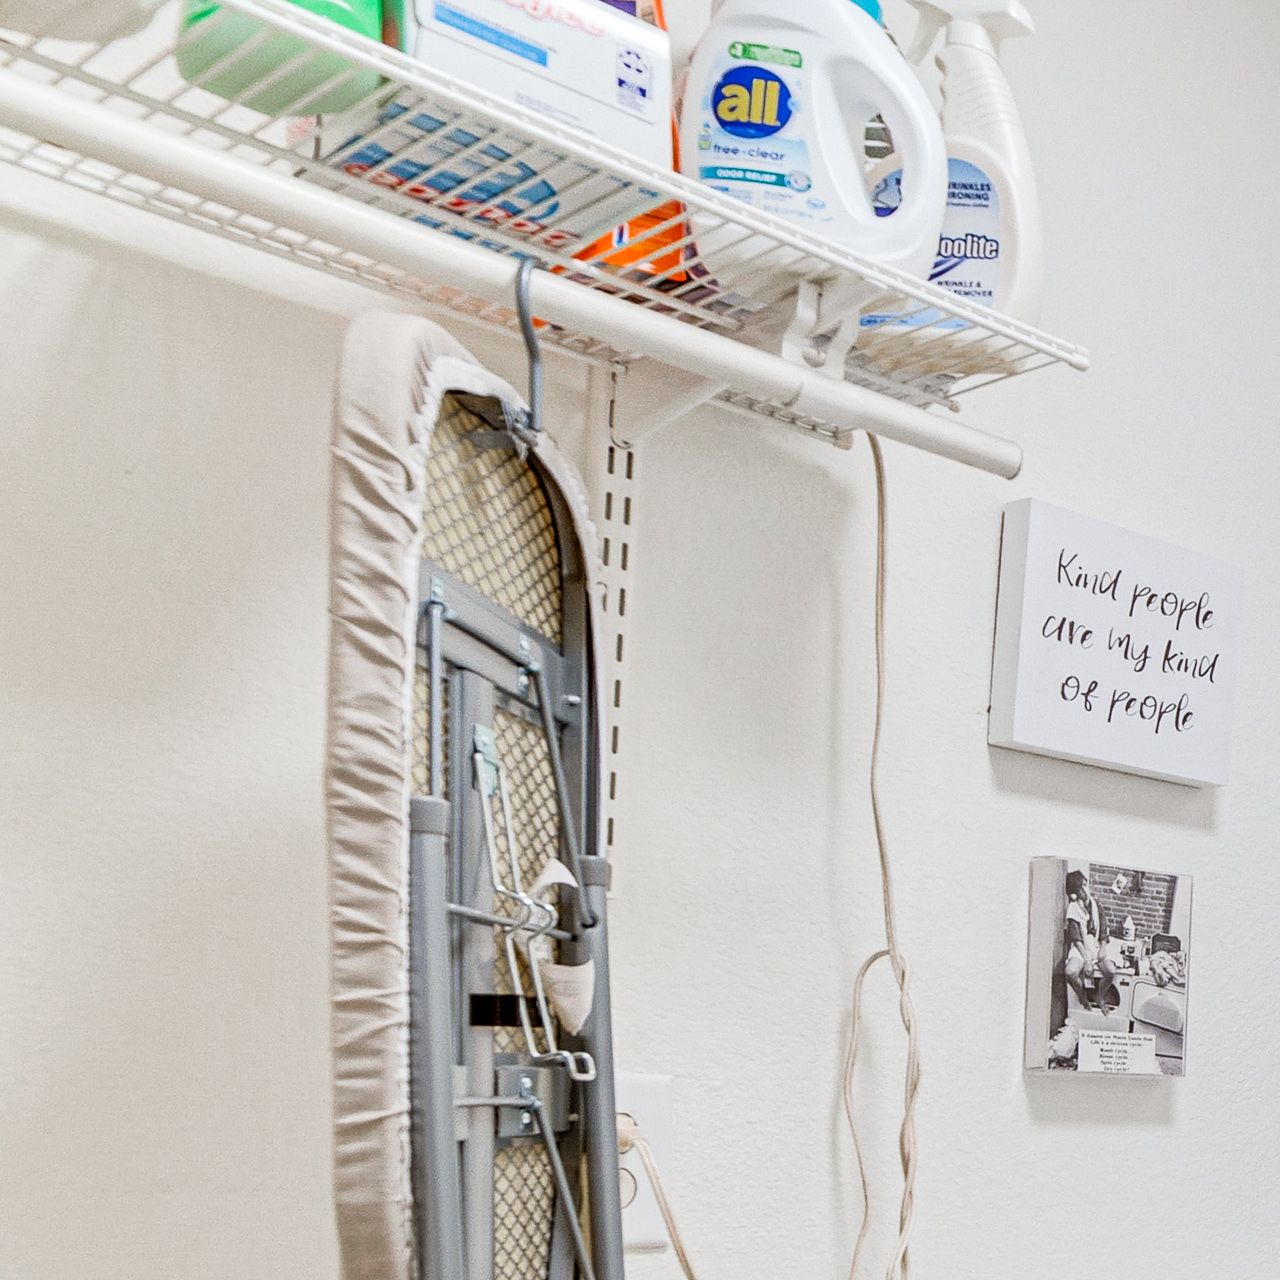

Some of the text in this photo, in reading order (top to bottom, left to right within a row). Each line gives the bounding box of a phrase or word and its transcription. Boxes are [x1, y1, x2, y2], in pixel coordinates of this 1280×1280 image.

[717, 79, 780, 126] all
[948, 182, 991, 192] RINKLES
[938, 233, 999, 259] oolite
[1057, 548, 1215, 631] Kind people
[1042, 615, 1220, 684] are my kind
[1108, 689, 1195, 734] people
